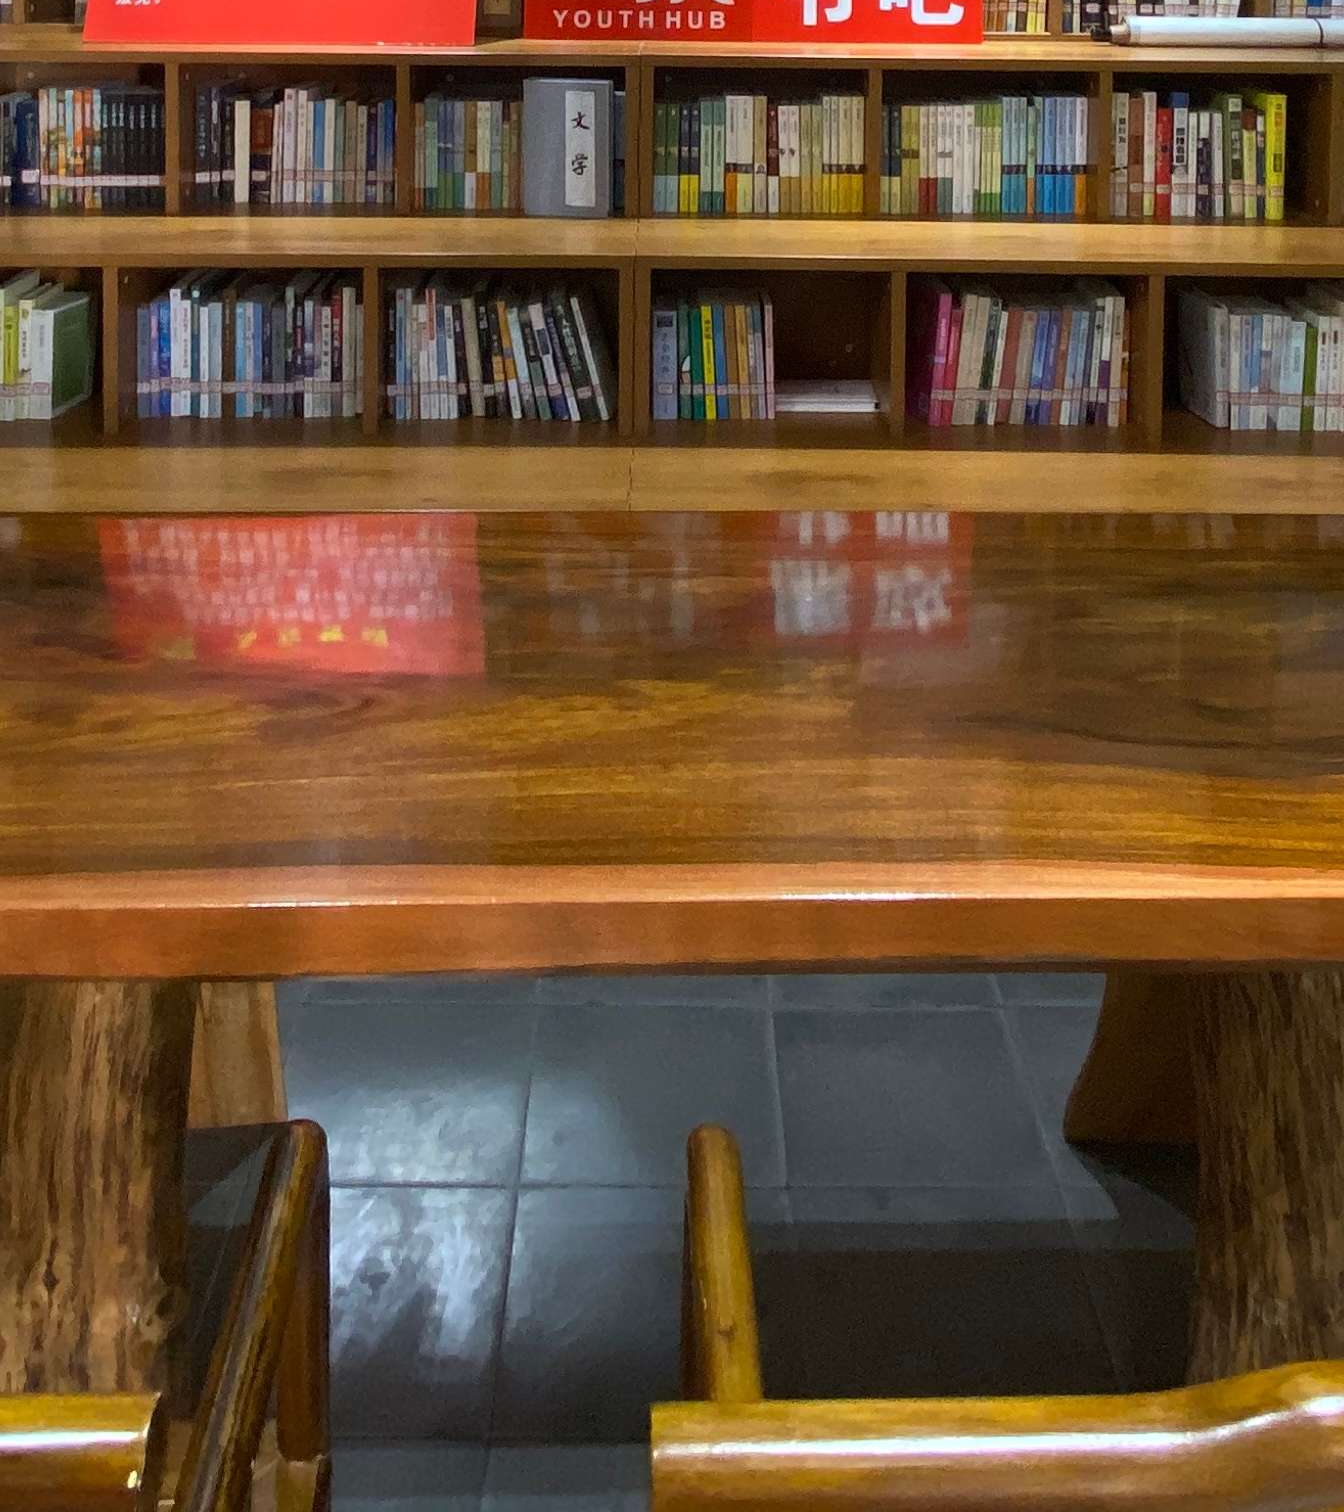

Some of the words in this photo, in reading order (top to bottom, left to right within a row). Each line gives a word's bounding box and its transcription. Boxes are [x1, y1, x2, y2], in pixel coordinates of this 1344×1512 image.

[553, 9, 655, 29] YOUTH
[665, 9, 726, 29] HUB
[570, 111, 591, 177] 文学
